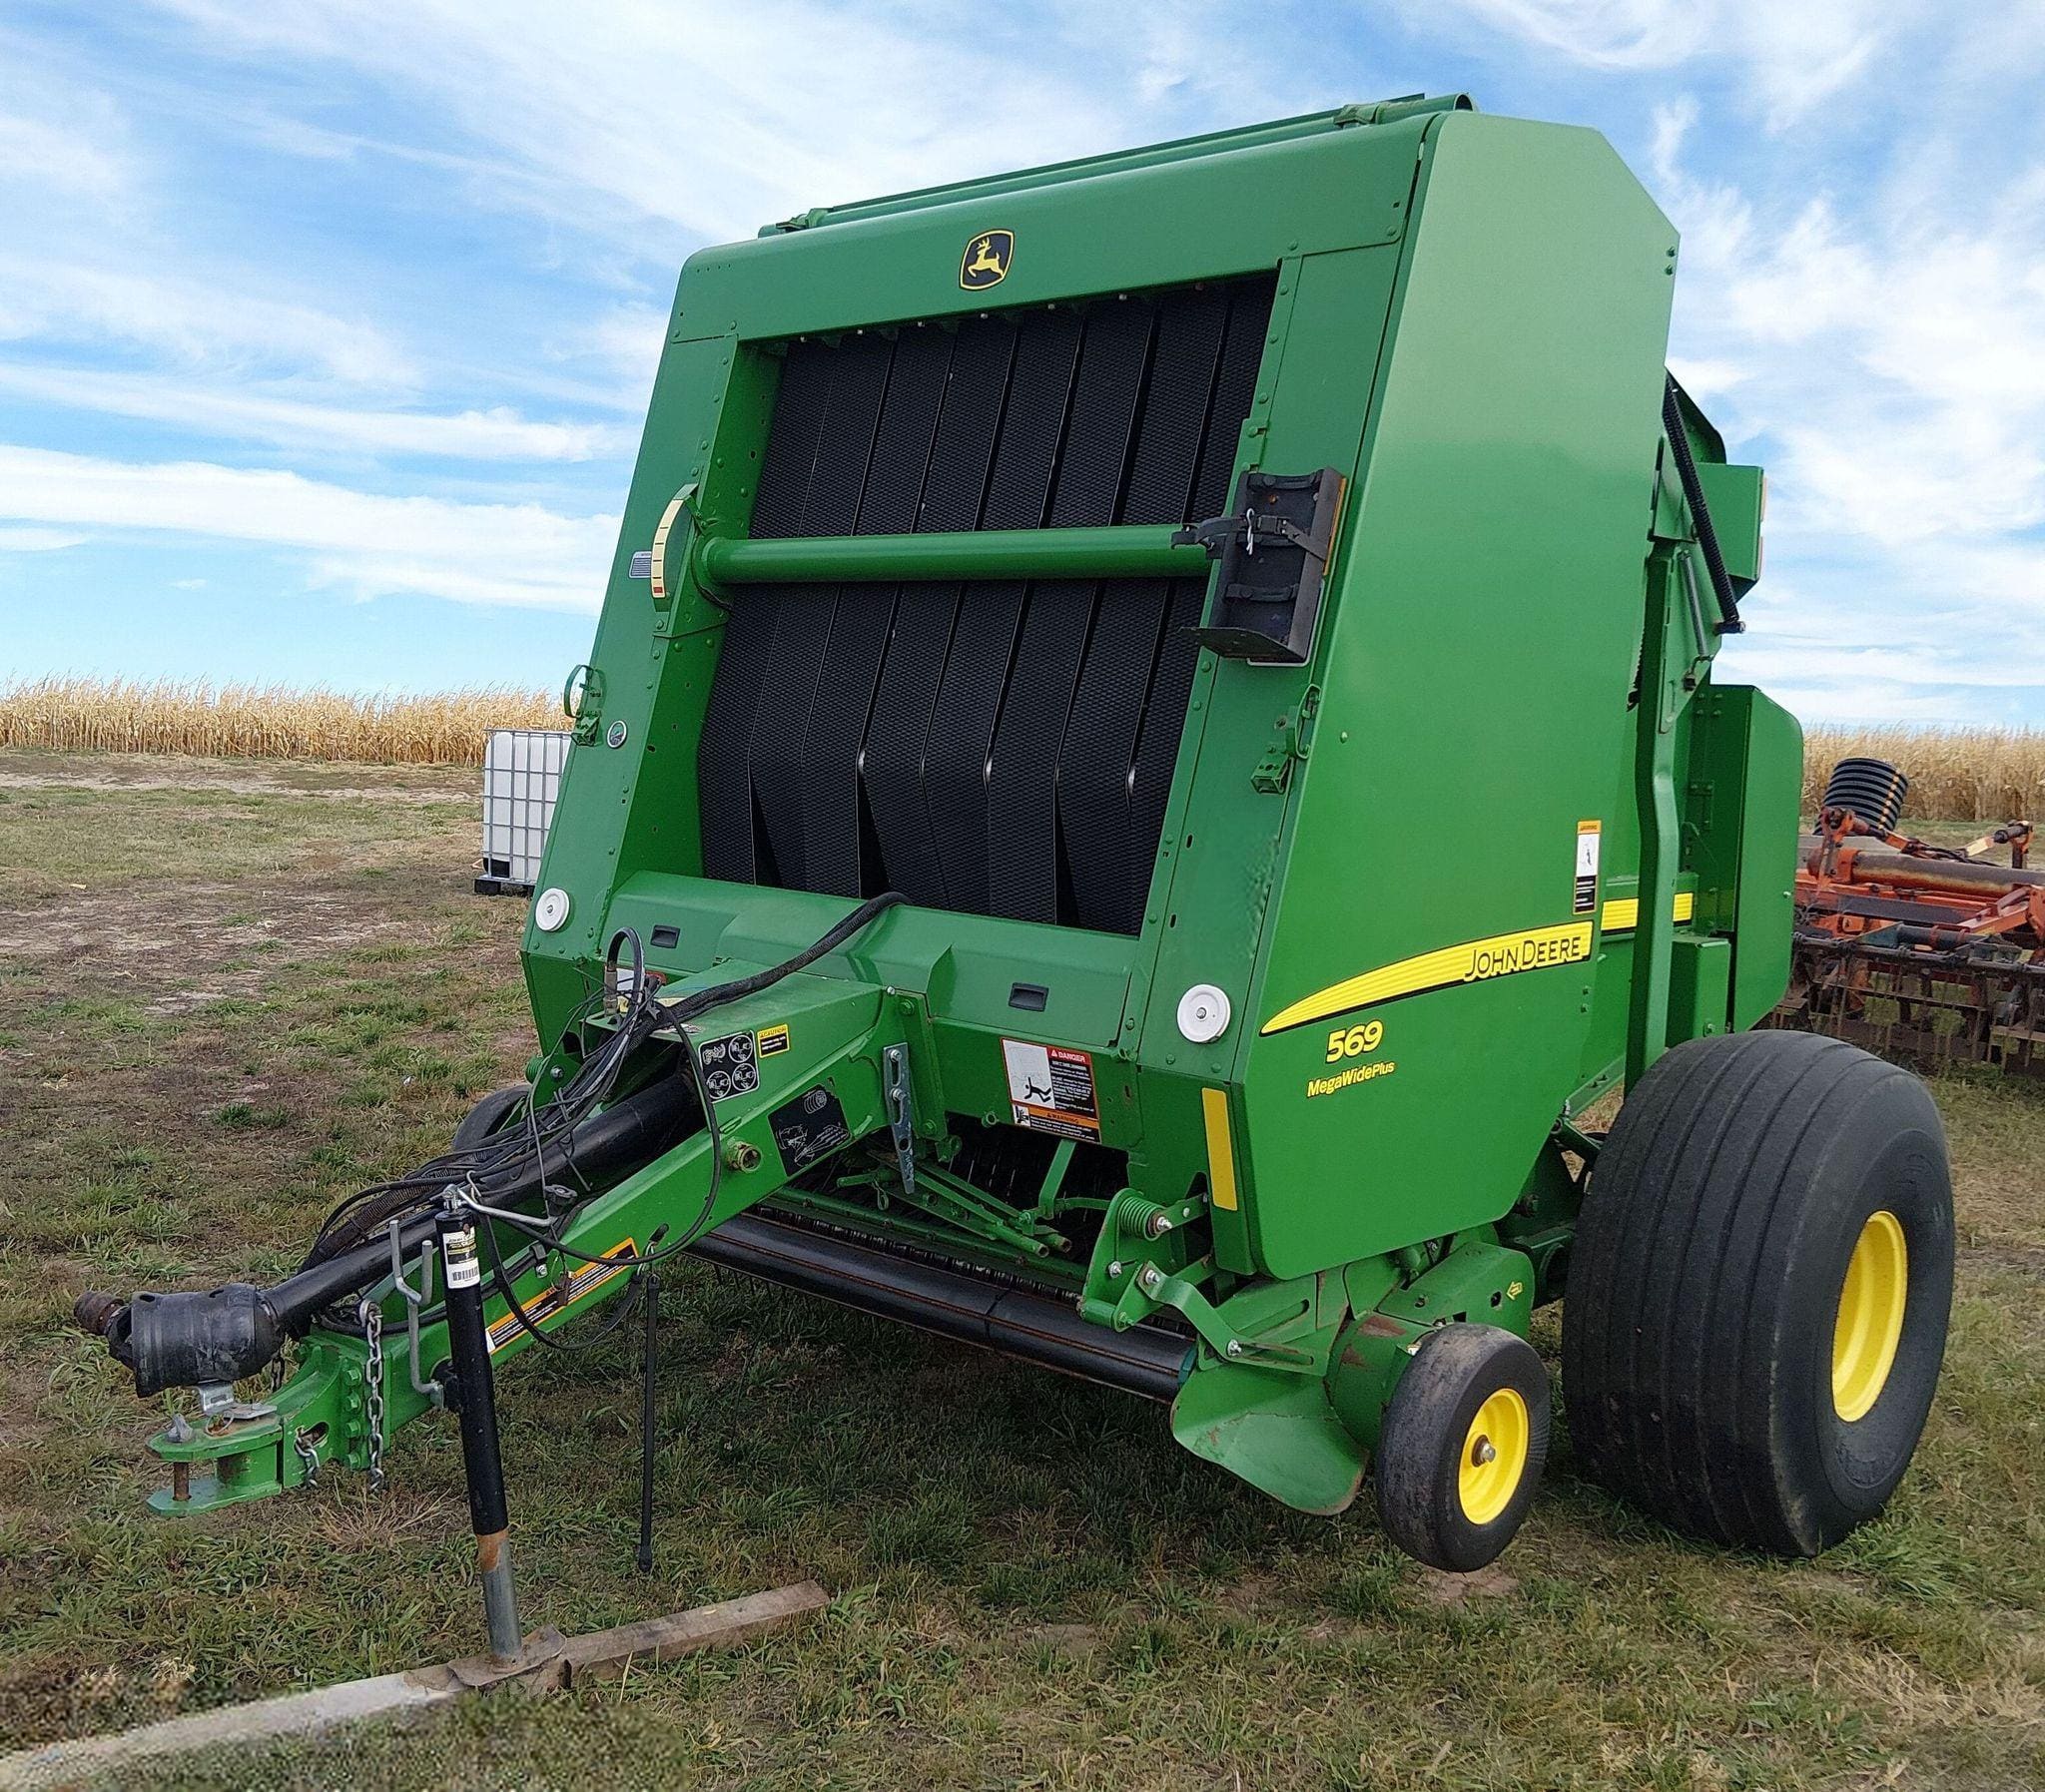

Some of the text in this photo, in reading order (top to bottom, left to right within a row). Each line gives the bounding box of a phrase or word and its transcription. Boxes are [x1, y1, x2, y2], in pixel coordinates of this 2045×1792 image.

[1464, 936, 1581, 977] JOHN DEERE
[1058, 1051, 1085, 1062] DANGER
[1325, 1018, 1385, 1064] 569
[1307, 1062, 1395, 1098] MegaWidePlus
